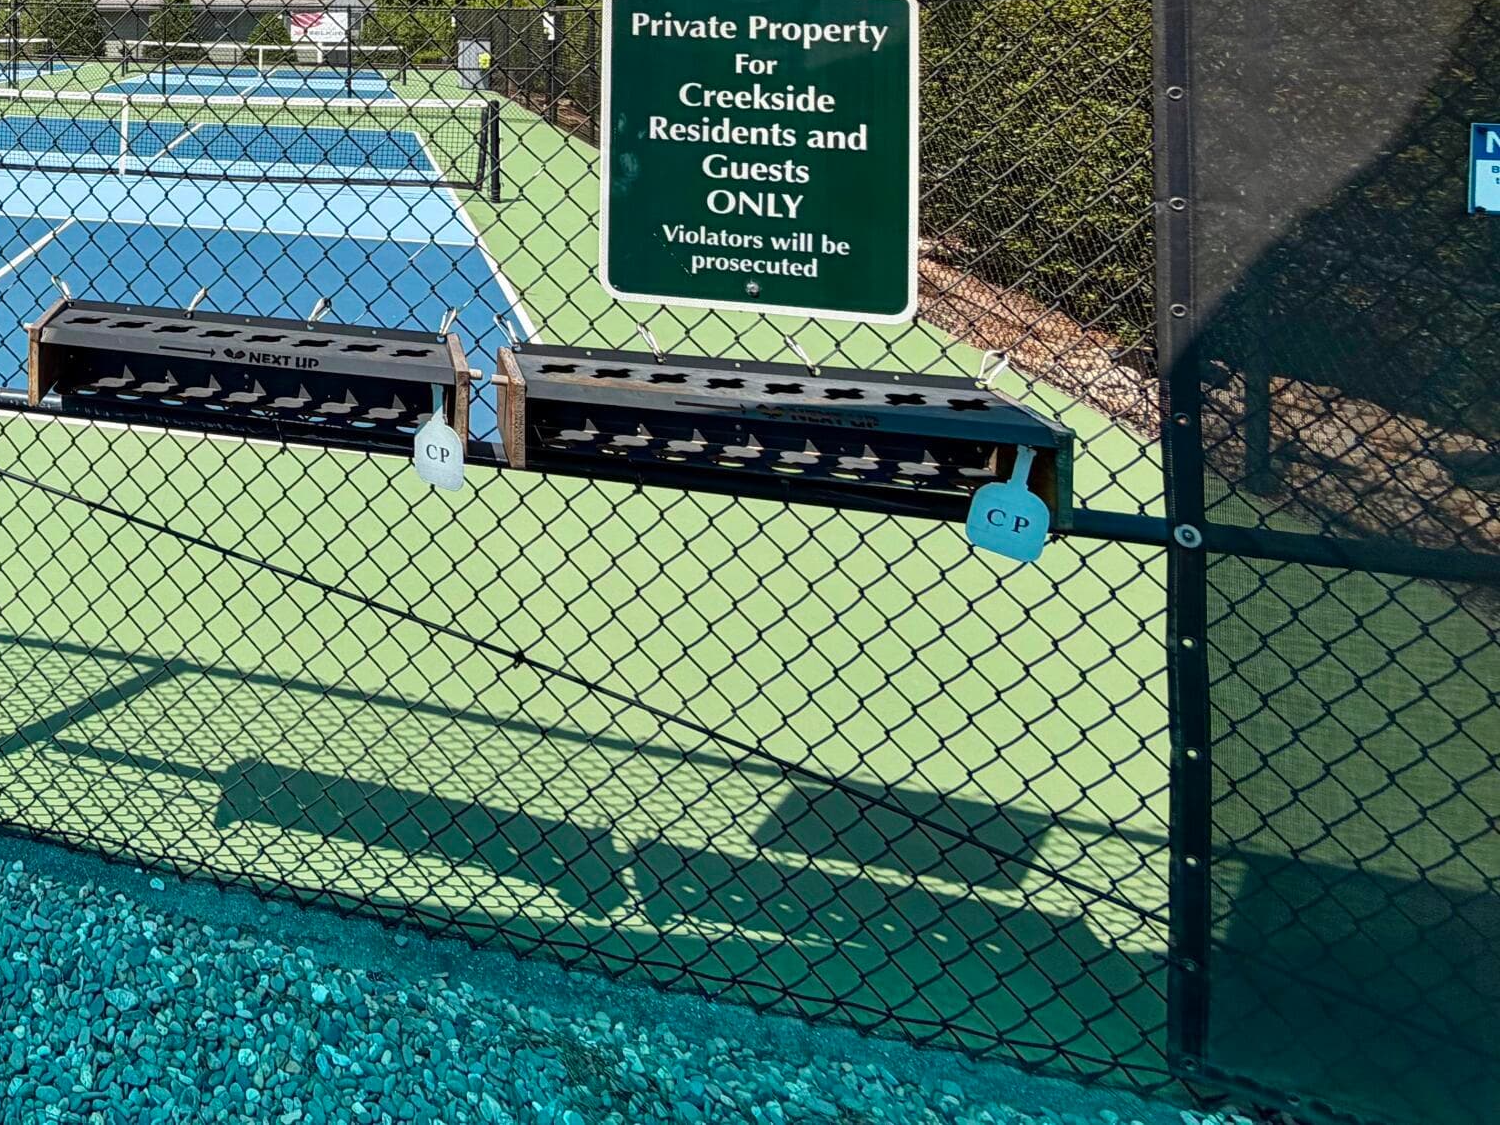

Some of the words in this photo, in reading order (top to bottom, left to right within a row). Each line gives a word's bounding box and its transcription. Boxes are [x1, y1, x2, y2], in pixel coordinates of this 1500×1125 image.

[631, 11, 738, 40] Private
[748, 15, 889, 51] Property
[734, 53, 778, 75] For
[678, 82, 836, 113] Creekside
[648, 115, 797, 148] Residents
[807, 123, 868, 151] and
[701, 153, 810, 184] Guests
[706, 189, 804, 220] ONLY
[662, 224, 764, 250] Violators
[770, 231, 813, 253] will
[821, 234, 851, 256] be
[691, 254, 818, 278] prosecuted
[248, 352, 291, 366] NEXT
[295, 357, 319, 369] UP
